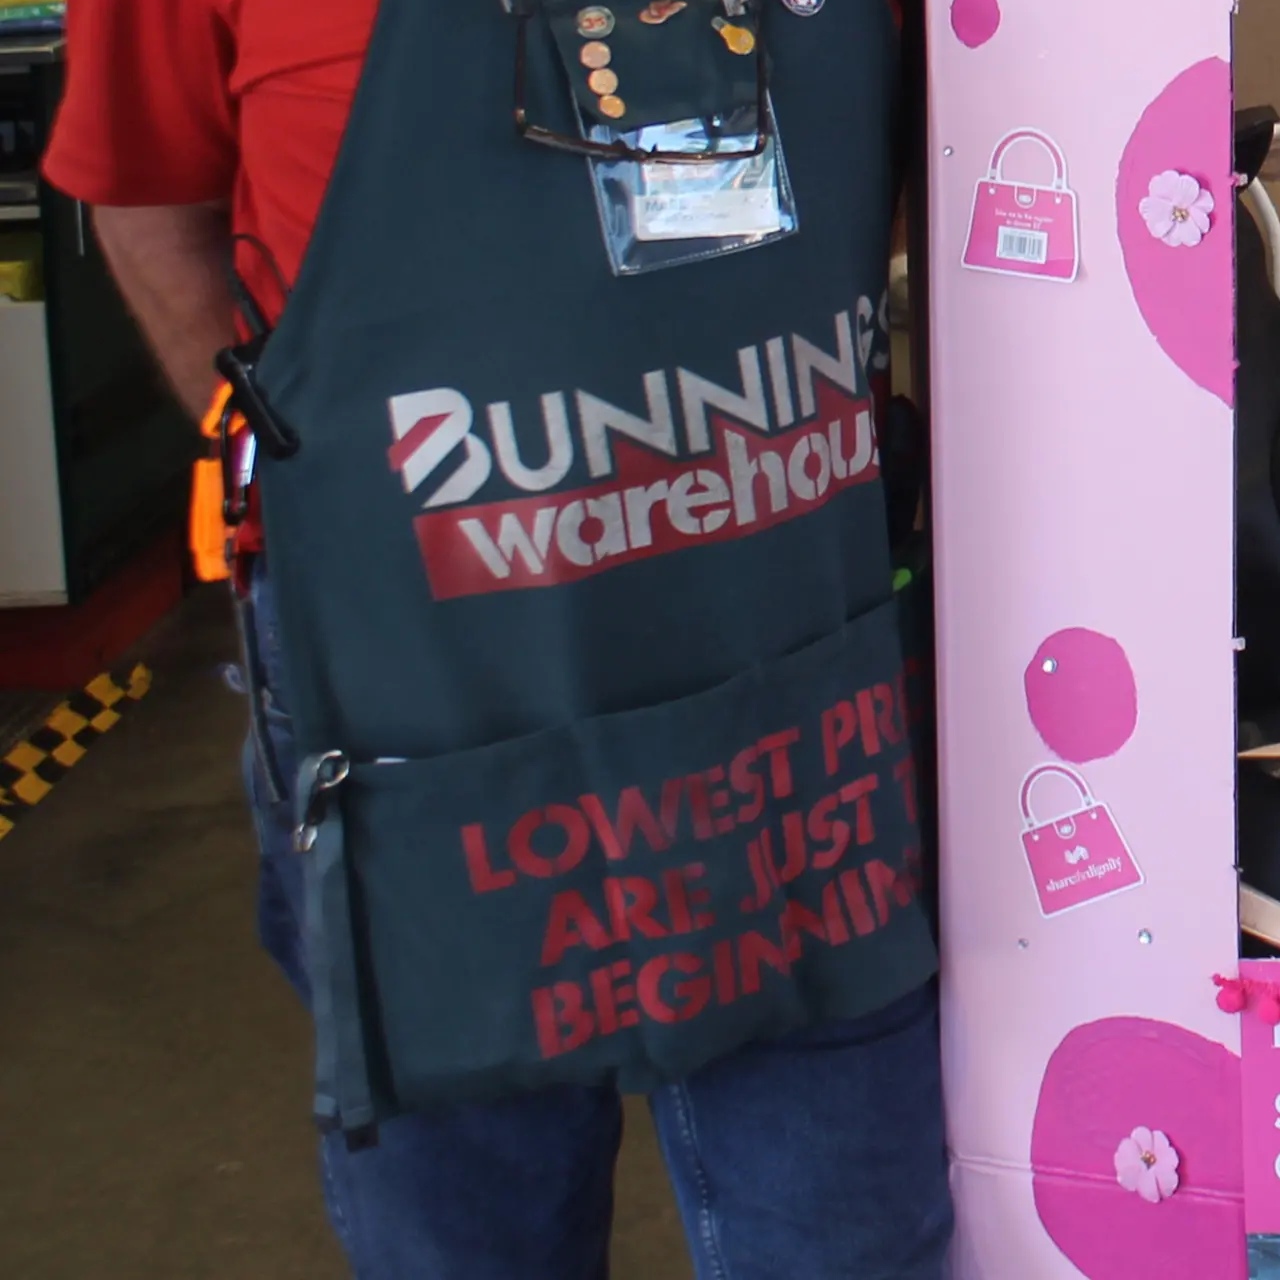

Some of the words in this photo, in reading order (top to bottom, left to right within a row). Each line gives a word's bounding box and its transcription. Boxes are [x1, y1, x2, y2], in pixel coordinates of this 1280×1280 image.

[459, 395, 880, 579] warehou
[460, 726, 800, 894] LOWEST
[540, 862, 715, 967] ARE
[739, 773, 879, 913] JUST
[531, 857, 920, 1060] BEGINNIN
